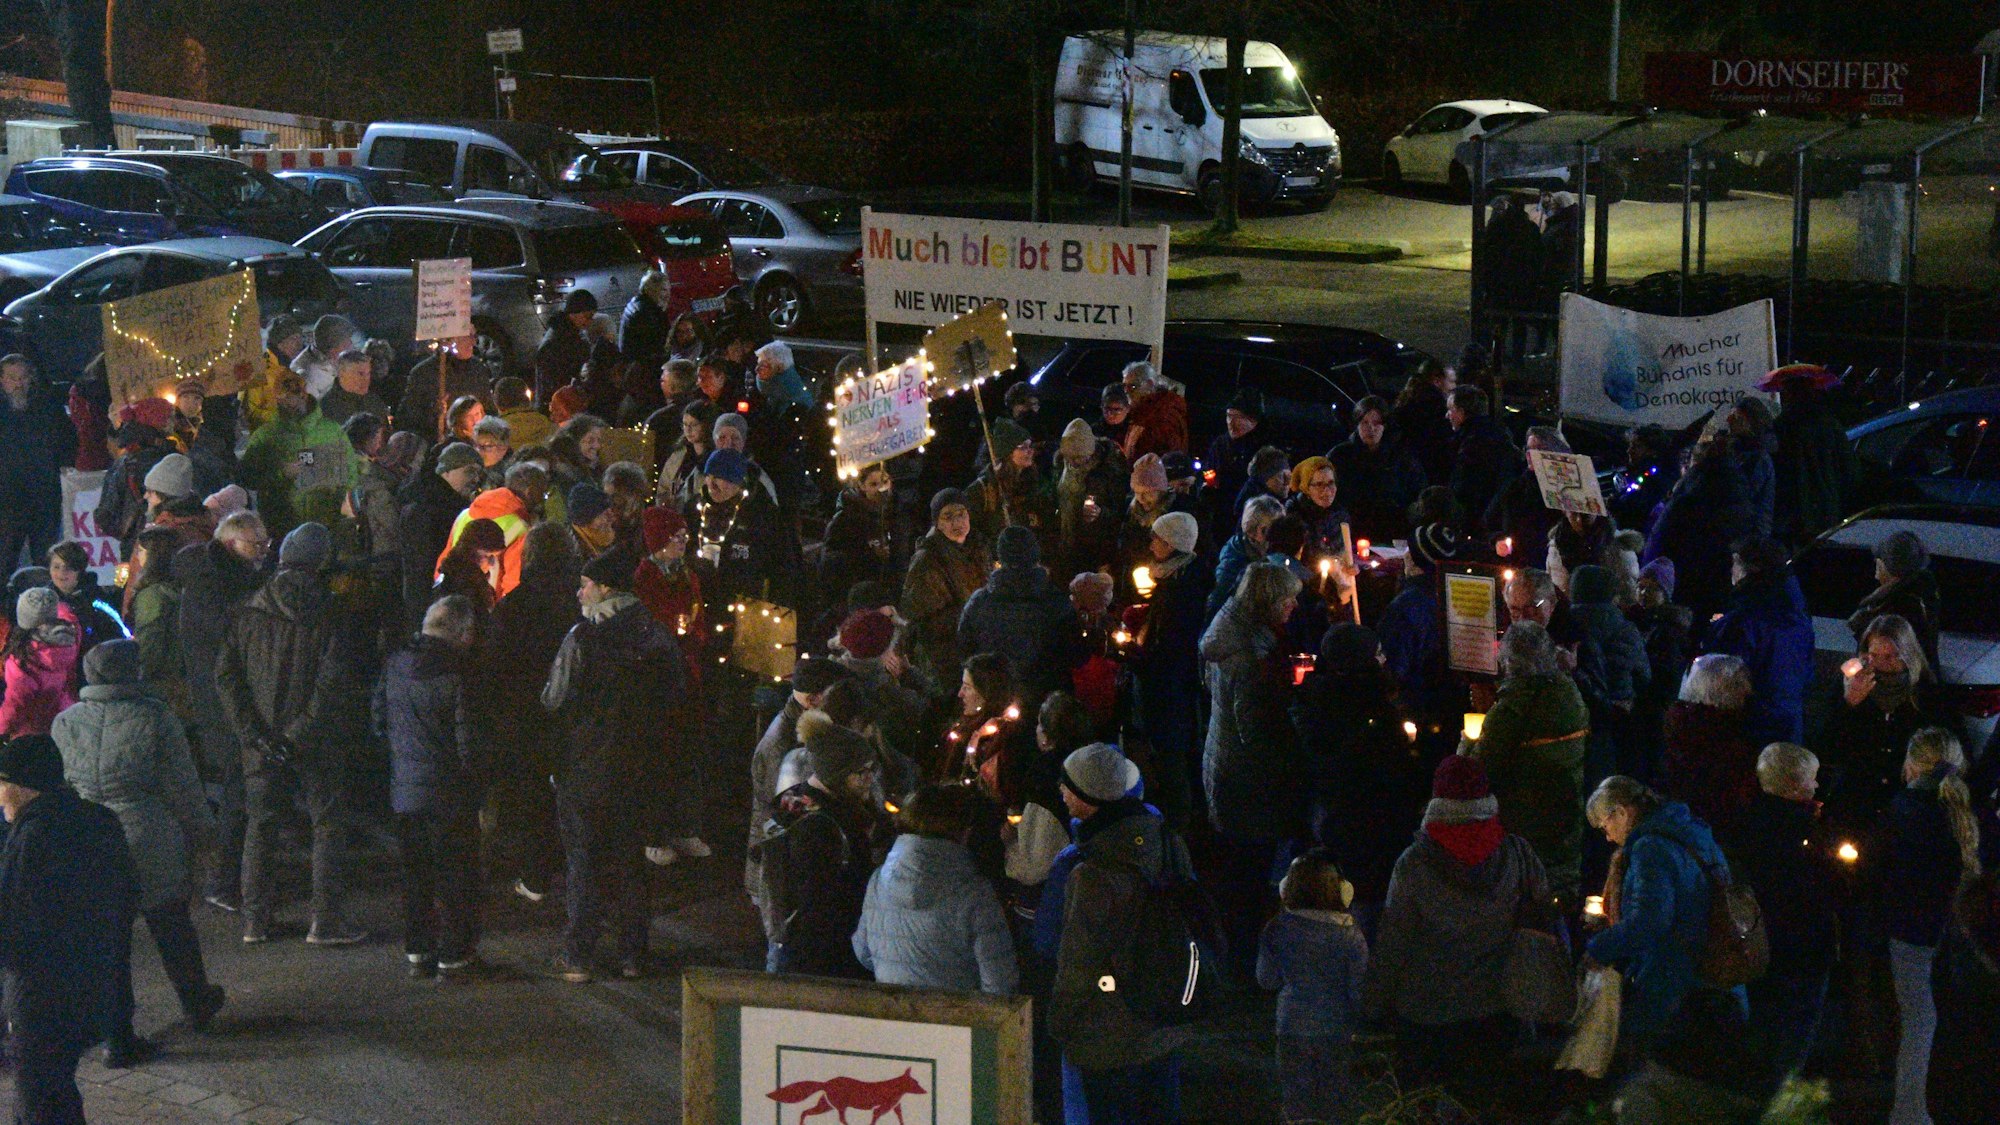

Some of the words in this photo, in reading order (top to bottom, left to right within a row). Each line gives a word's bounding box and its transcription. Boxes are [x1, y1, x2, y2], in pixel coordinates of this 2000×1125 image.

[869, 227, 949, 265] Much
[962, 233, 1050, 271] bleibt
[1062, 239, 1158, 276] BUNT
[894, 289, 925, 311] NIE
[1016, 299, 1047, 321] IST
[1053, 302, 1120, 326] JETZT
[1662, 333, 1742, 359] Mucher
[857, 366, 913, 402] NAZIS
[1636, 361, 1711, 385] Bündnis
[1716, 358, 1744, 377] für
[842, 396, 892, 429] NERVEN
[1634, 387, 1746, 408] Demokratie
[876, 412, 901, 432] ALS
